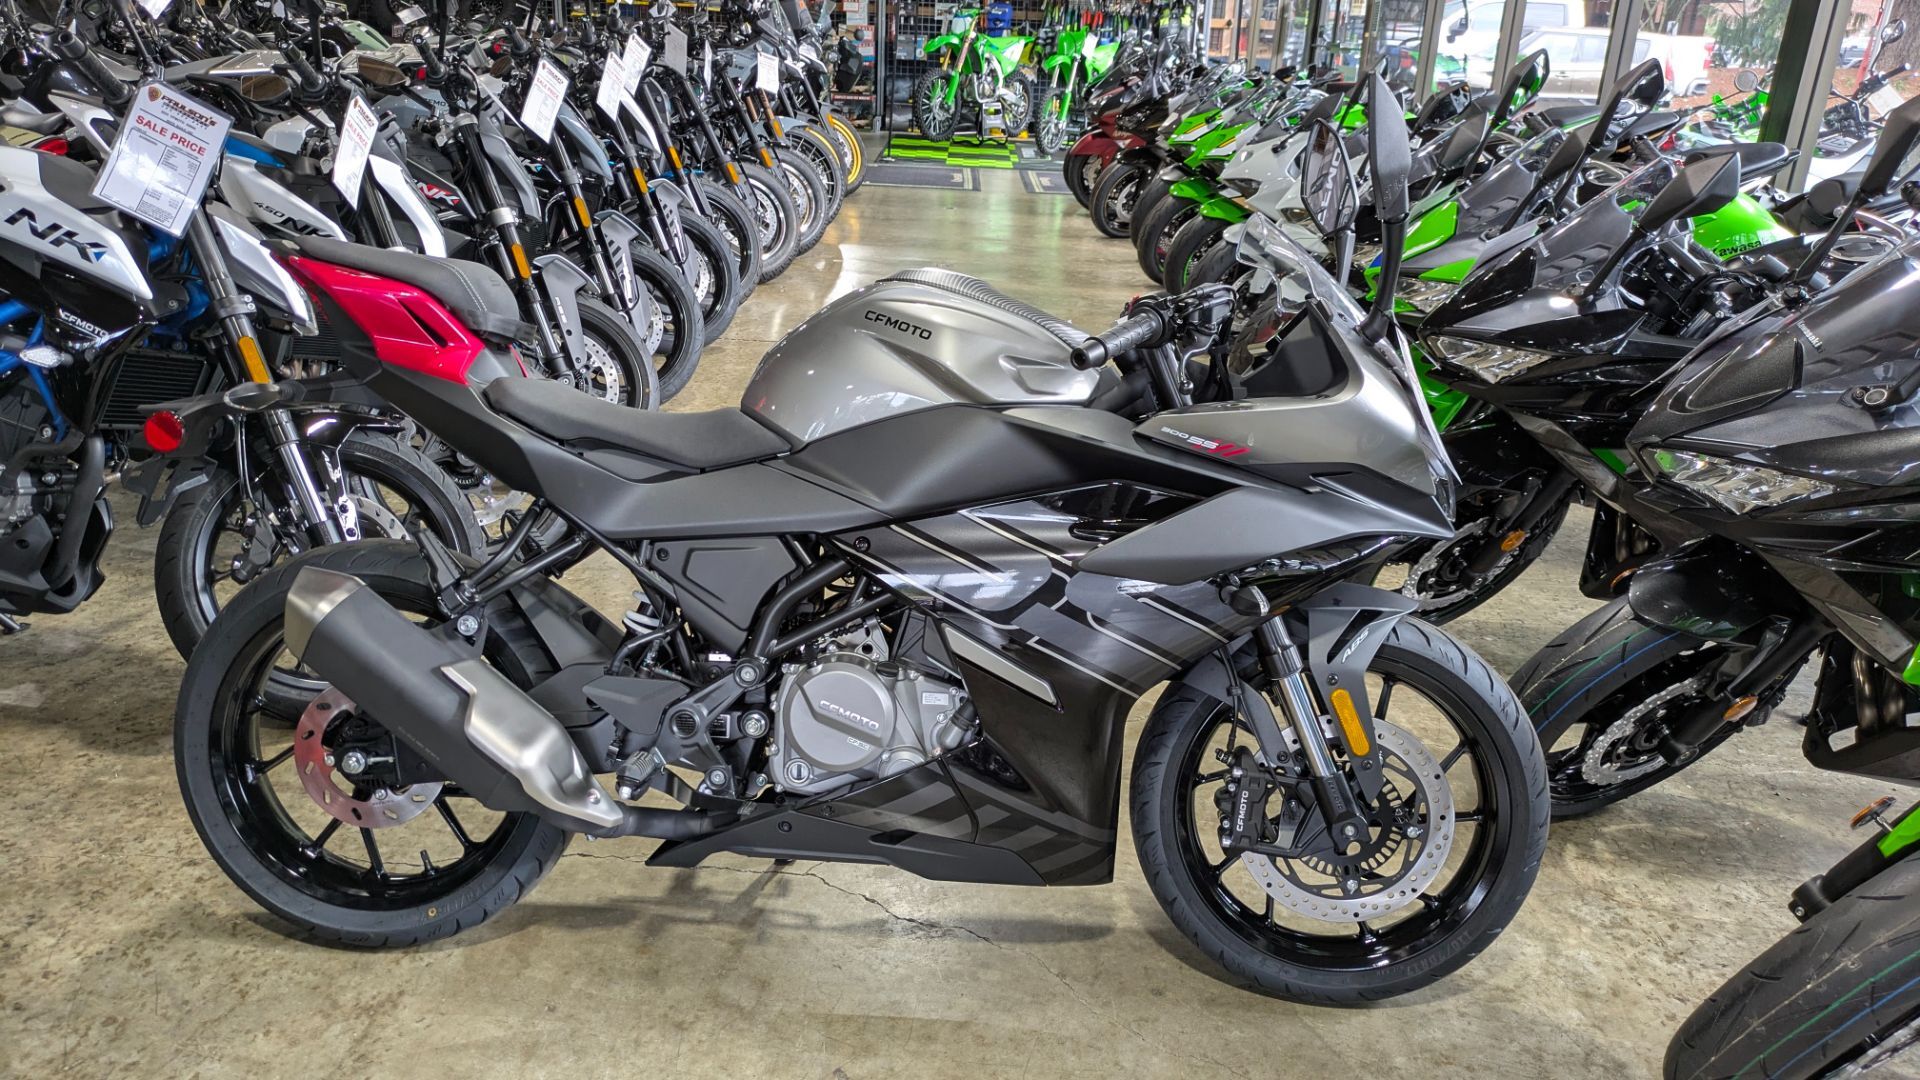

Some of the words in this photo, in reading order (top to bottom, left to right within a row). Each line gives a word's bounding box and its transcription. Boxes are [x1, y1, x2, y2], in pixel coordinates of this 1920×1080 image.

[135, 114, 169, 138] SALE
[169, 132, 208, 158] PRICE
[253, 201, 286, 218] 450
[4, 207, 108, 264] NK
[60, 312, 110, 338] CFMOTO
[864, 310, 933, 341] CFMOTO
[1341, 627, 1369, 664] ABS
[819, 700, 880, 731] CFMOTO
[1236, 790, 1249, 832] CFMOTO
